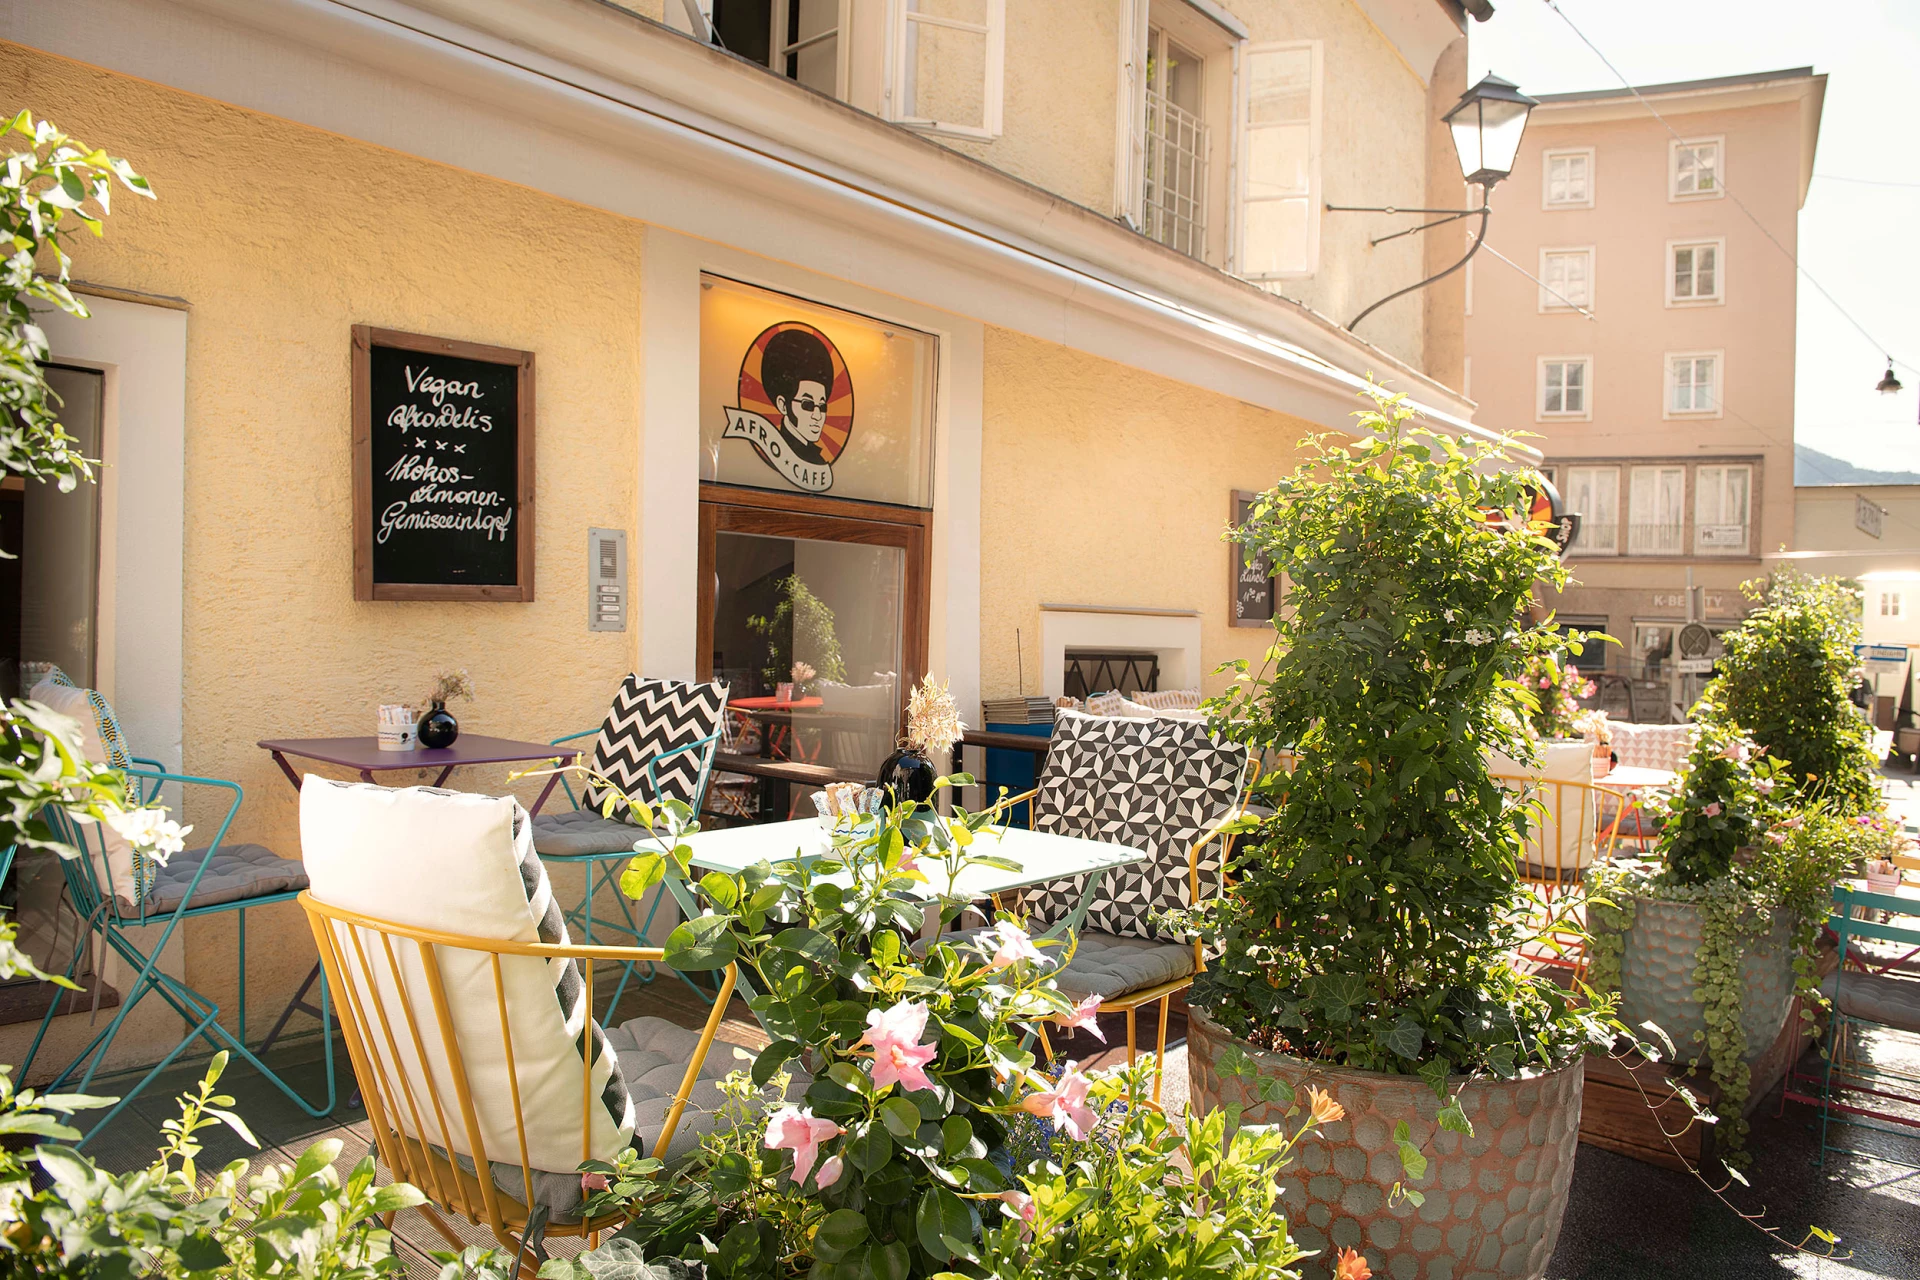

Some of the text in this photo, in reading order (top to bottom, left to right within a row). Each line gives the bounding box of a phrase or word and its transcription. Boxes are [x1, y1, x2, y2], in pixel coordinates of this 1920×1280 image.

[404, 365, 485, 407] Vegan
[734, 417, 827, 486] AFRO CAFE
[385, 453, 475, 484] Kokos-
[410, 484, 506, 505] Limonen-
[1653, 595, 1723, 608] K-BETY
